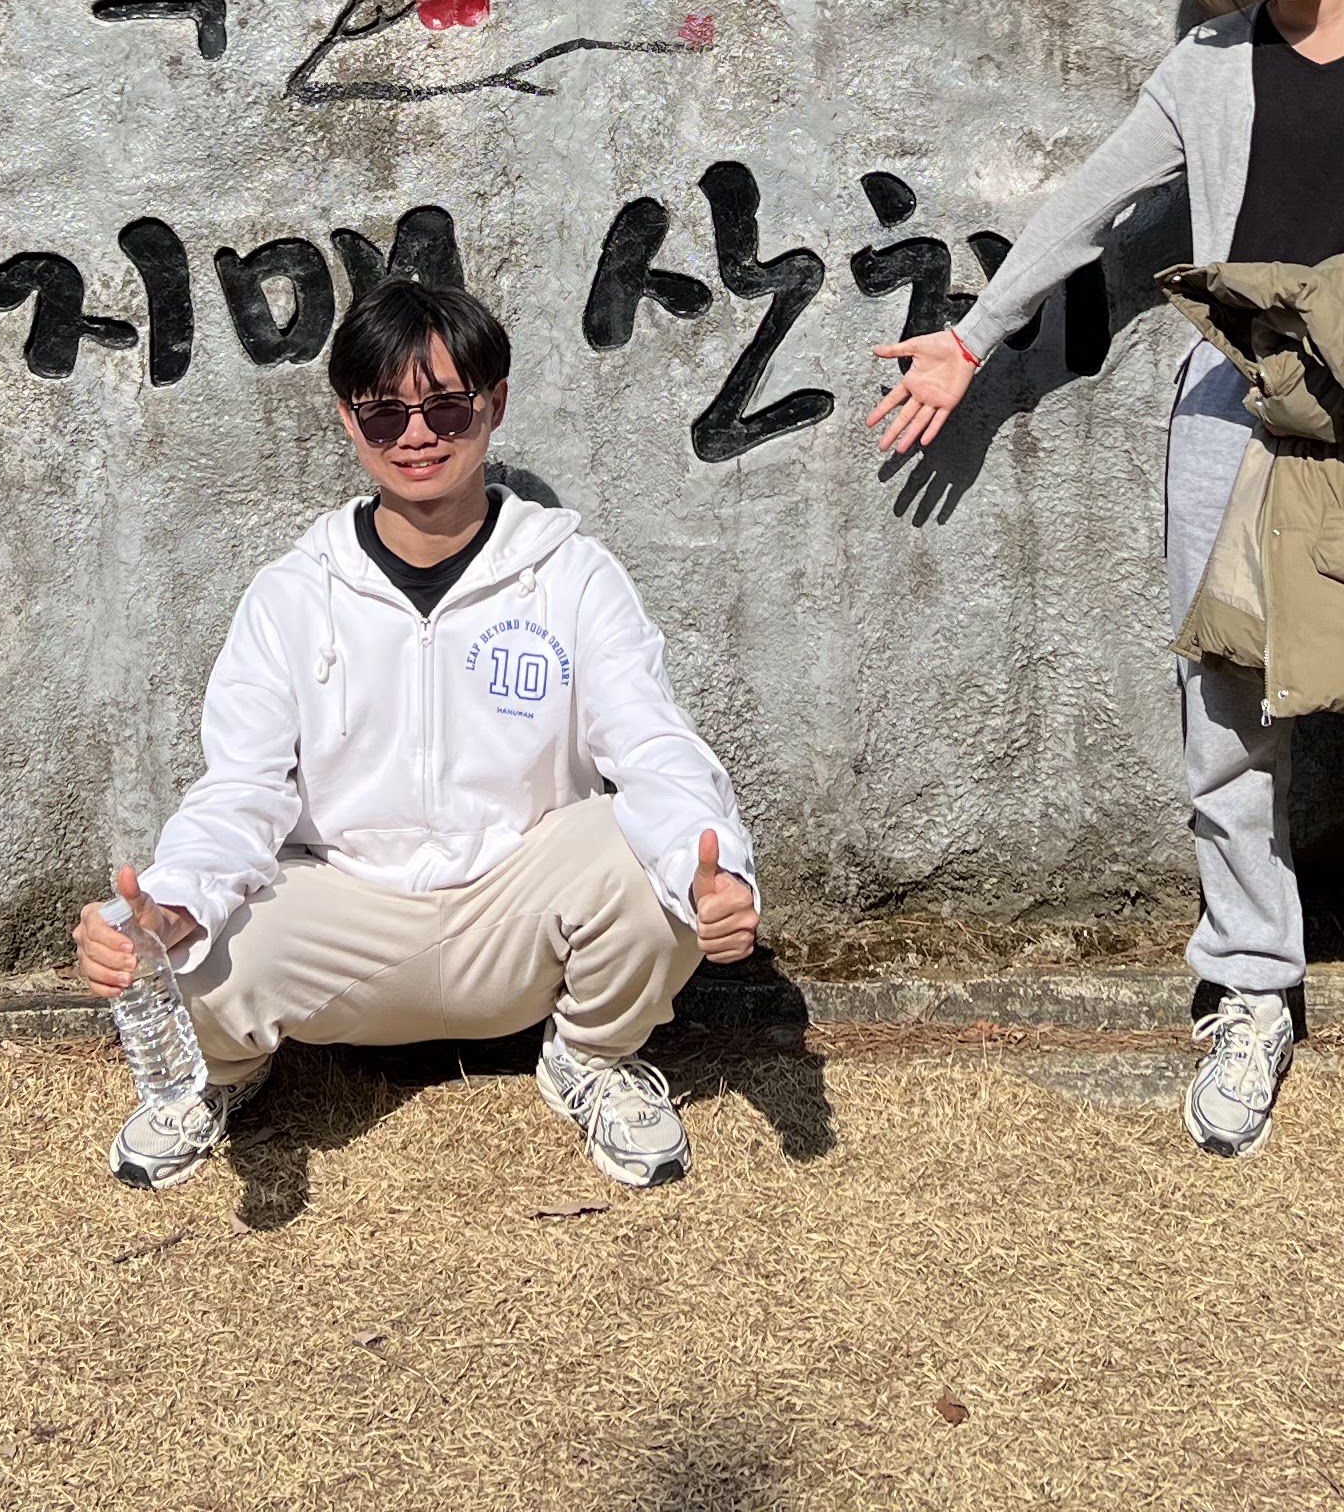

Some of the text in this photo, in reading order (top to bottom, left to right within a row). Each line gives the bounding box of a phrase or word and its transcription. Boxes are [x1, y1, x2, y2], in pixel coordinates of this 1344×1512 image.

[465, 619, 570, 686] LEAP BEYOND YOUR ORDINARY
[488, 646, 548, 701] 10
